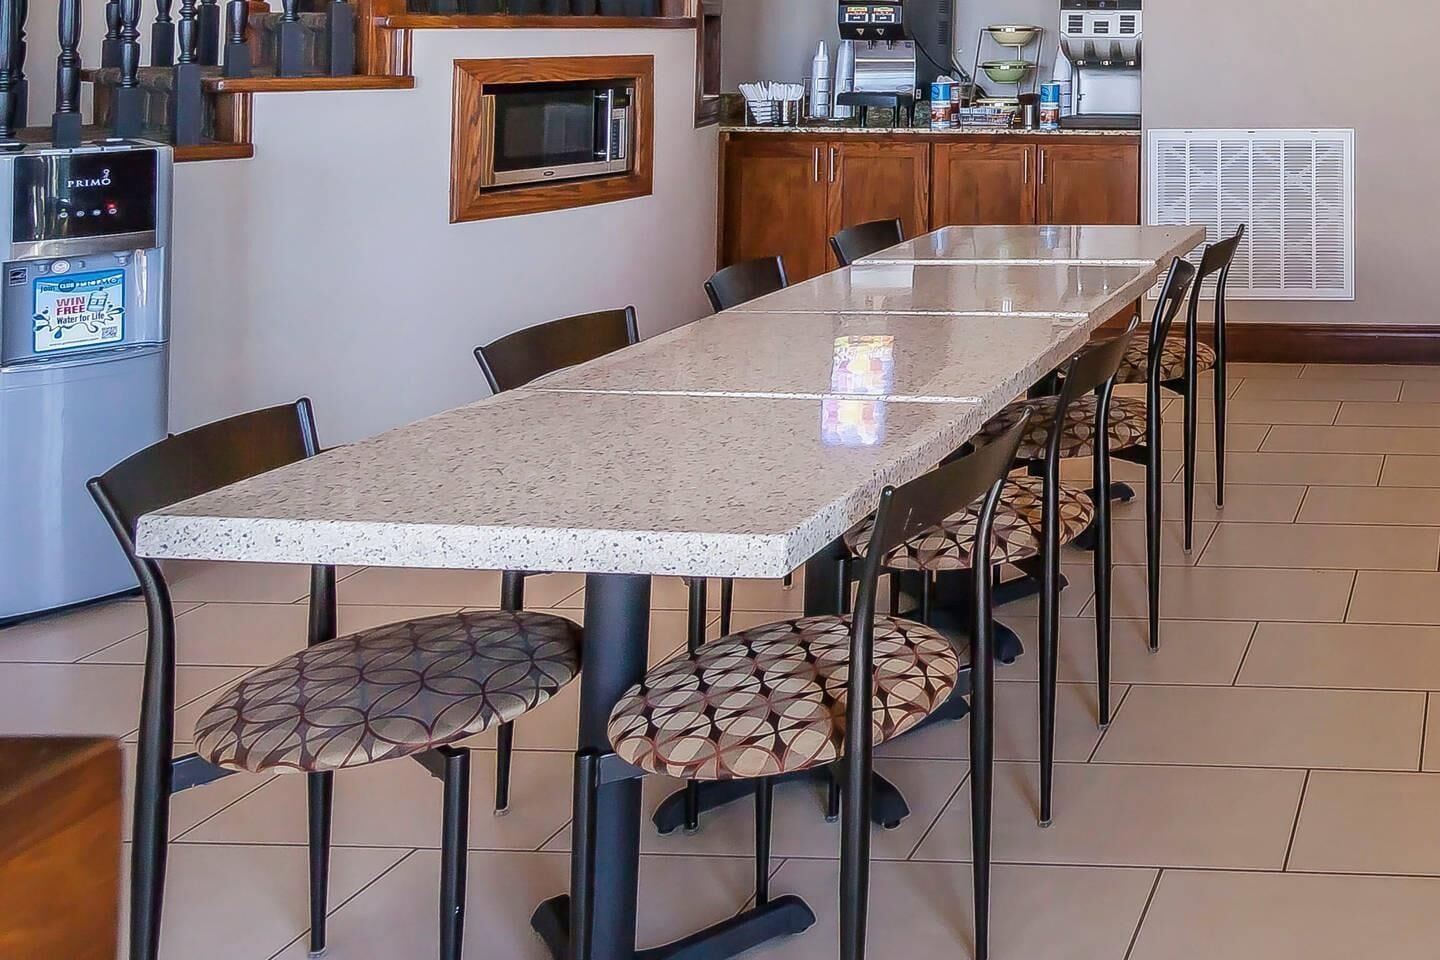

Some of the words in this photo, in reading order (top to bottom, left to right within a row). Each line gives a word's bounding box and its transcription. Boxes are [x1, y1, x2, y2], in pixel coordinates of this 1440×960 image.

[67, 175, 111, 189] PRIMO
[56, 297, 85, 307] WIN
[56, 305, 85, 315] FREE
[57, 315, 78, 324] Water
[79, 314, 89, 322] for
[92, 312, 105, 320] Life
